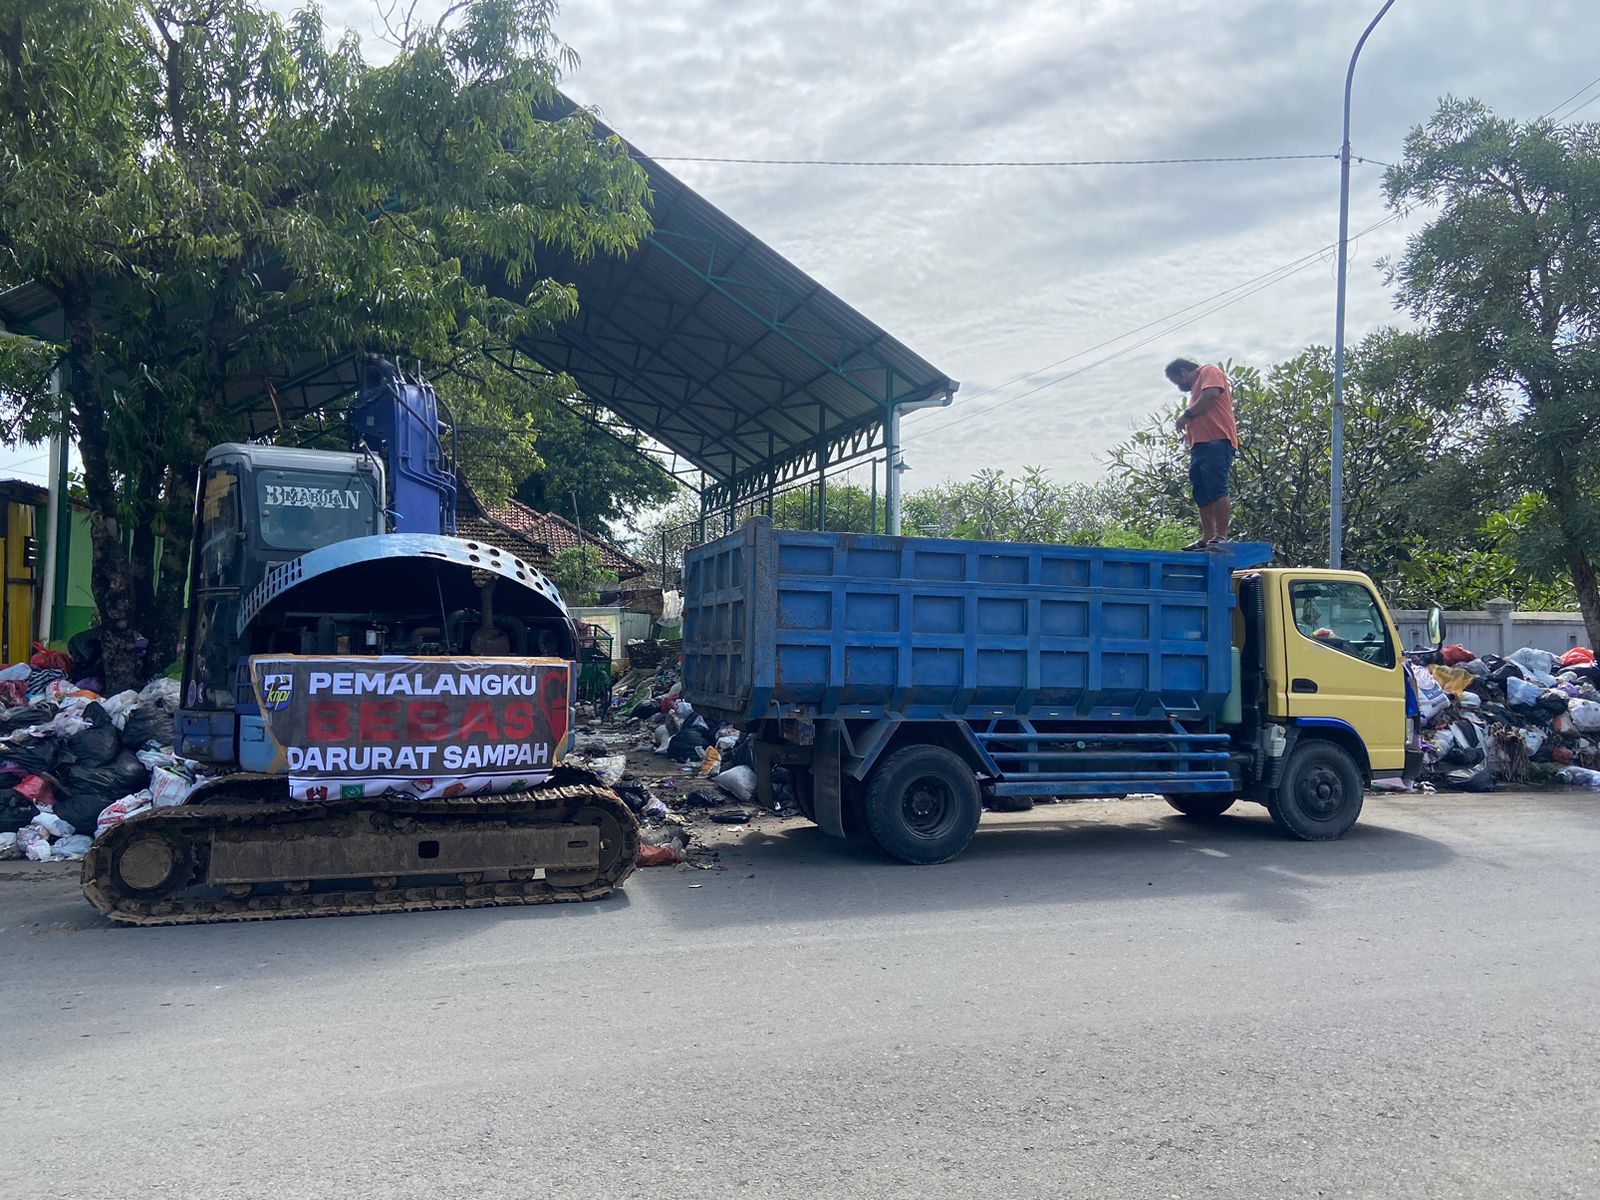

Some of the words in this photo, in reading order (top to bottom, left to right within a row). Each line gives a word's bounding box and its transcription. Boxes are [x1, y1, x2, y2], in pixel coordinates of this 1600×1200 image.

[308, 672, 536, 696] PEMALANGKU
[306, 700, 536, 741] BEBAS
[286, 746, 438, 771] DARURAT
[442, 742, 549, 769] SAMPAH
